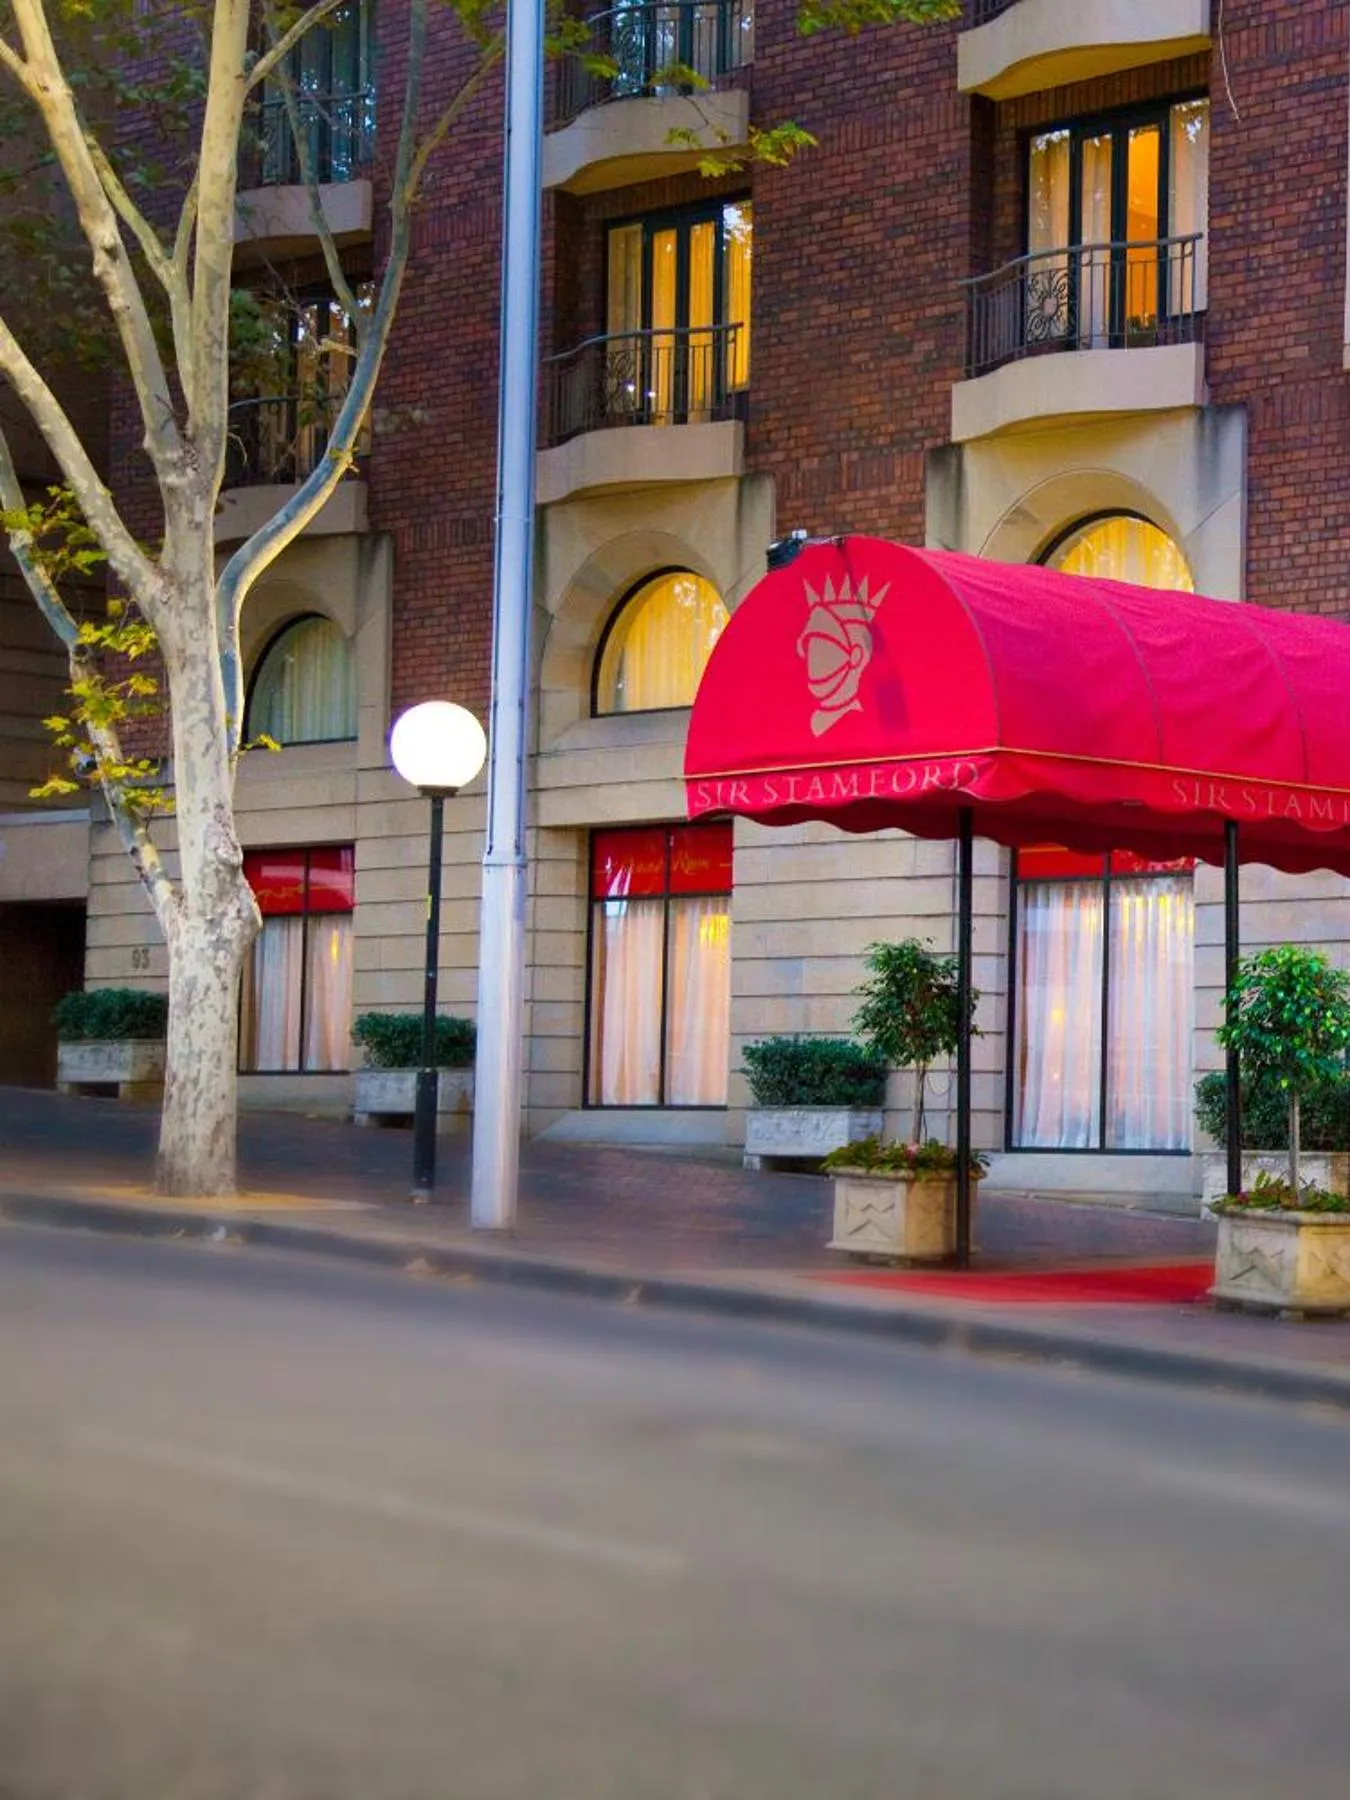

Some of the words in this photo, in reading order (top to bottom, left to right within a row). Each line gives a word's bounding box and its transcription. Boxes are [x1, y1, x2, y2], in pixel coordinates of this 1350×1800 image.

[695, 780, 749, 808] SIR
[763, 762, 980, 804] STAMFORD
[1172, 779, 1232, 810] SIR
